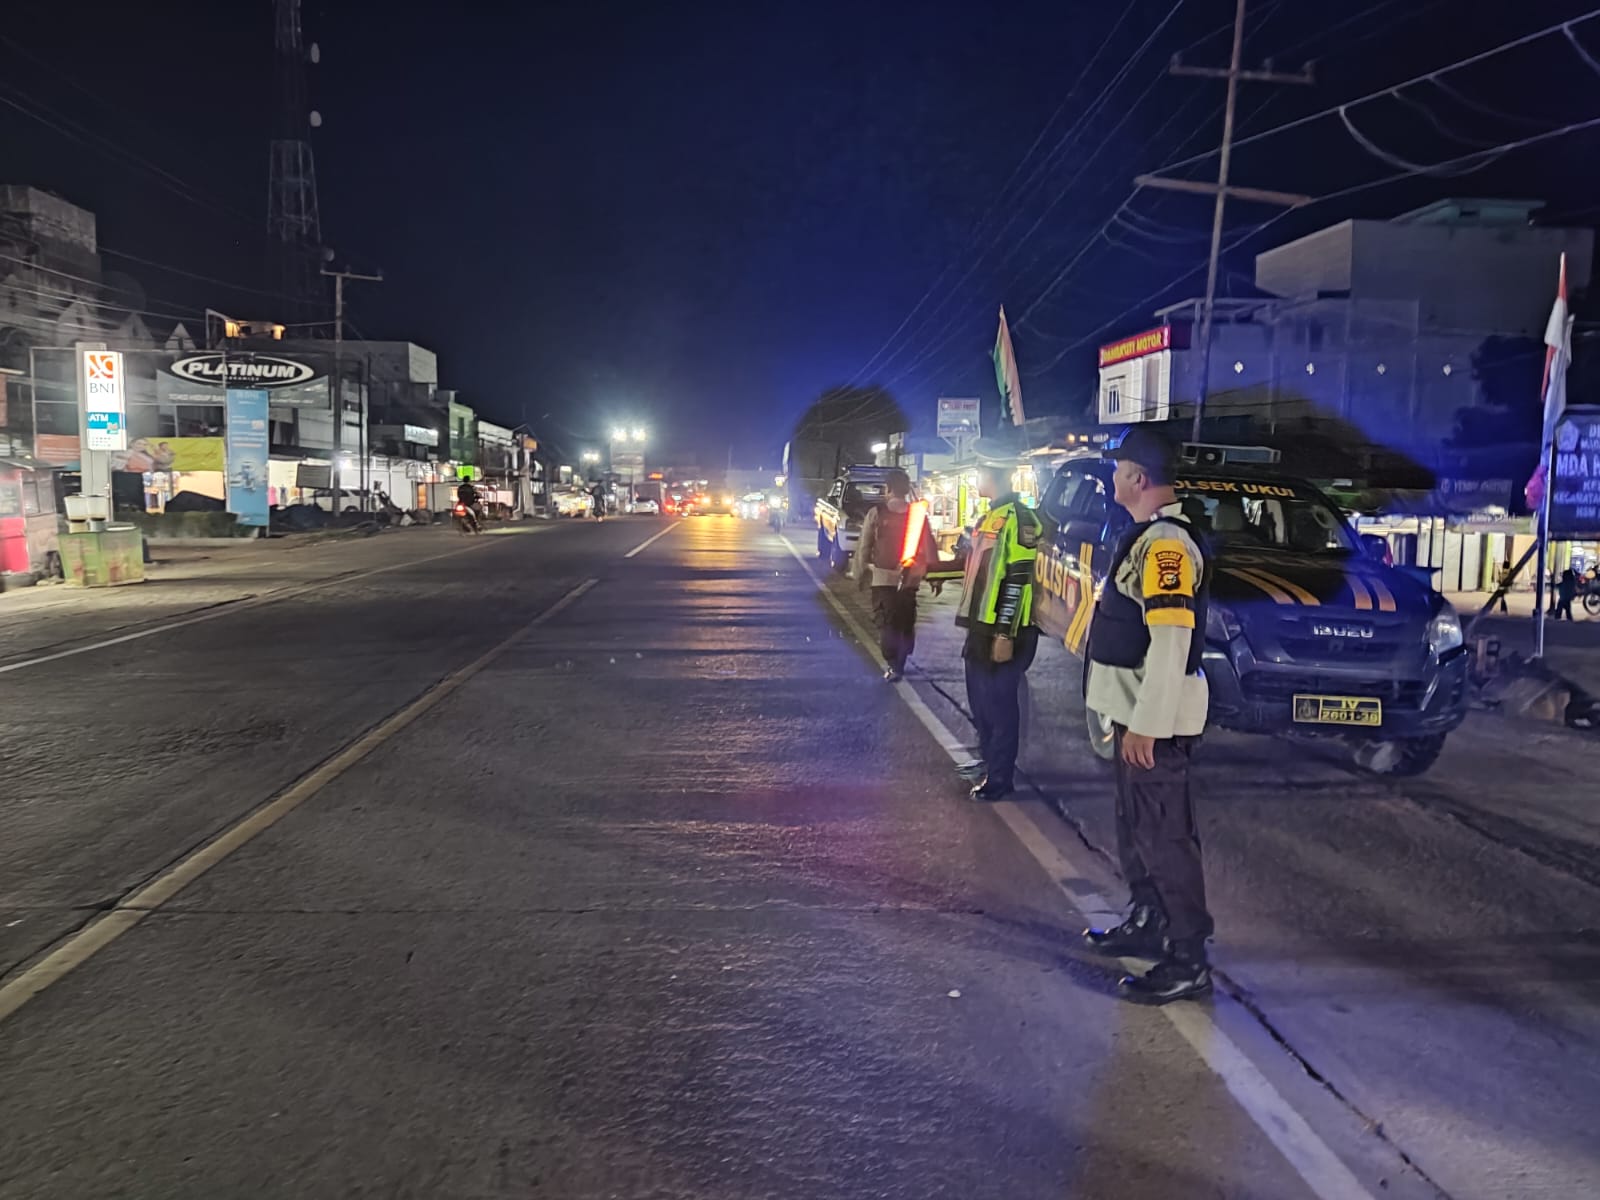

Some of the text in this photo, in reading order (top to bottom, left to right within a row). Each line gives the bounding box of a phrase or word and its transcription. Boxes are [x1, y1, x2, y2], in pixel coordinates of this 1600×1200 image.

[188, 363, 295, 378] PLATINUM
[90, 383, 114, 394] BNI
[89, 413, 109, 422] ATM
[1556, 453, 1589, 477] MDA
[1176, 480, 1296, 497] OLSEK UKUI
[1553, 490, 1600, 504] KECAMATA
[1036, 551, 1068, 600] OLISI
[1313, 624, 1373, 638] ISUZU
[1341, 698, 1360, 709] IV
